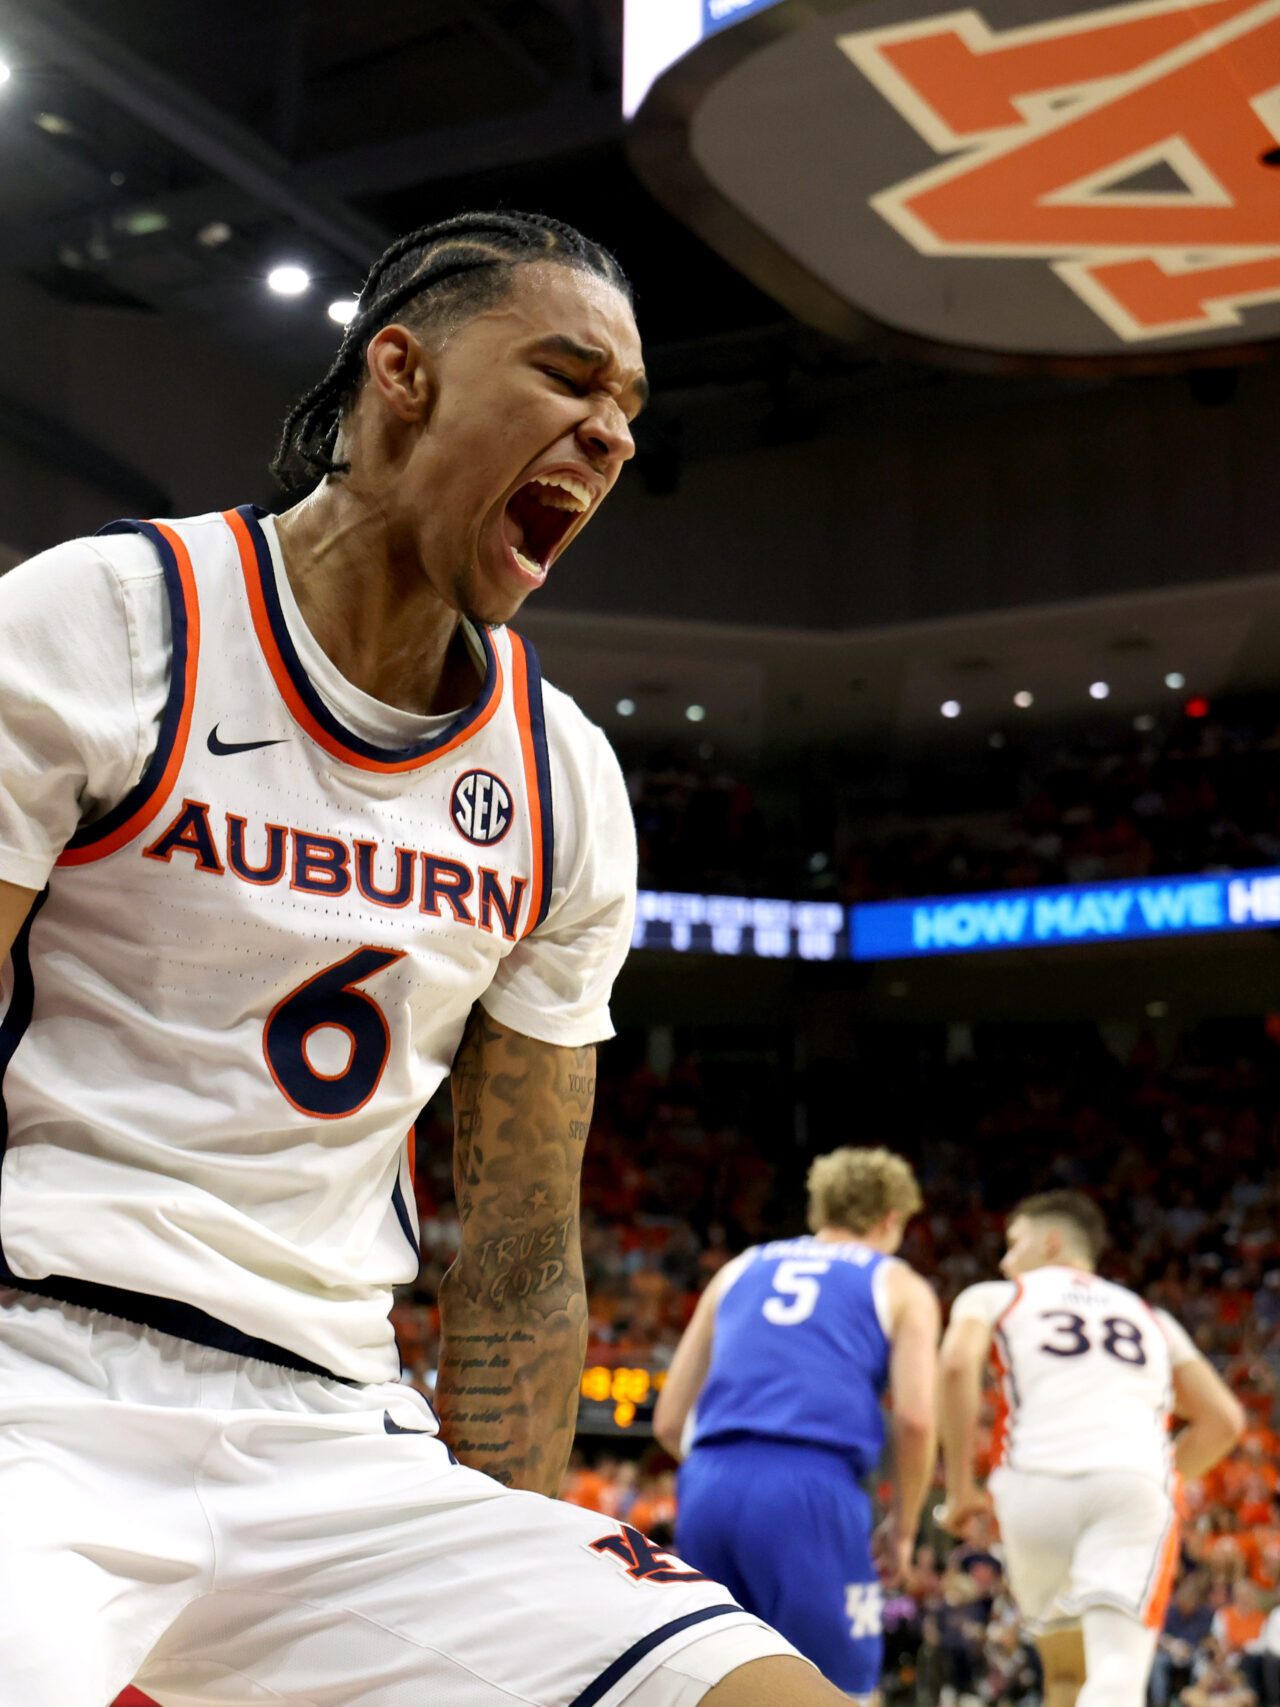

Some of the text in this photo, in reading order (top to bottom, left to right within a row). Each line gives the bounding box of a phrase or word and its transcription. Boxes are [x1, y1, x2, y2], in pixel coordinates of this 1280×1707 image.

[455, 773, 509, 841] SEC
[142, 798, 528, 941] AUBURN
[913, 901, 1026, 949] HOW
[1033, 888, 1131, 940] MAY
[1135, 881, 1220, 931] WE
[263, 945, 409, 1119] 6
[763, 1260, 830, 1326] 5
[1039, 1312, 1147, 1367] 38
